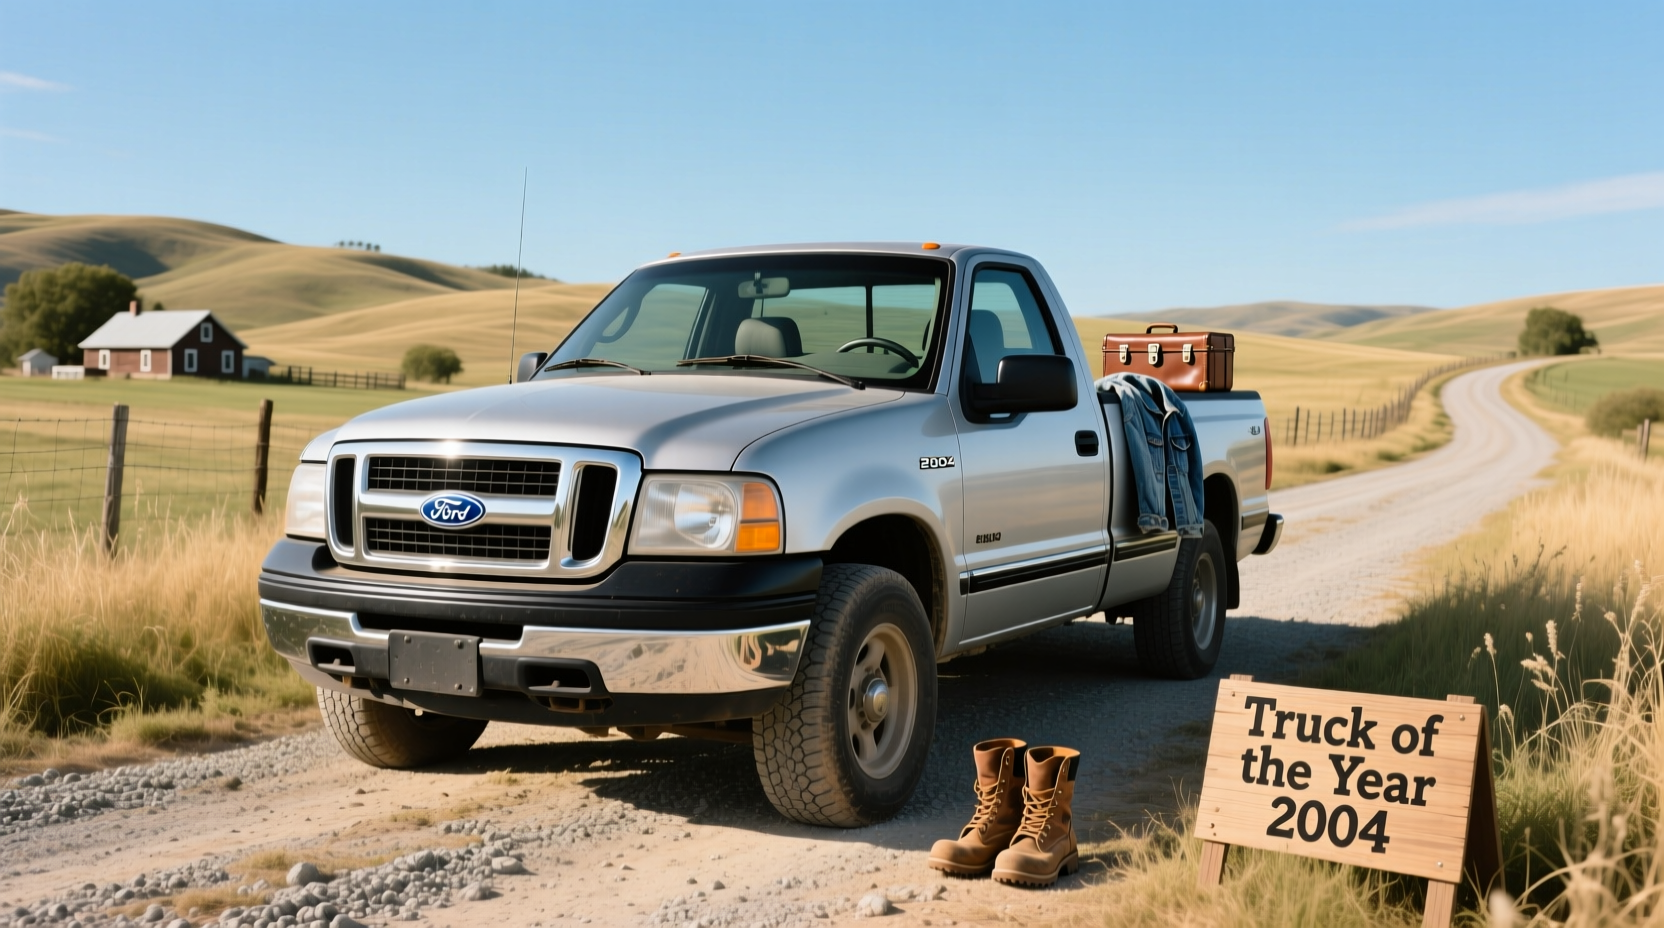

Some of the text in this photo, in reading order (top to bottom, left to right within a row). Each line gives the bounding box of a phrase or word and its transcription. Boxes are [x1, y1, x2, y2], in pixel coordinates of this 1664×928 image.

[919, 456, 955, 469] 2004
[430, 498, 472, 521] Ford
[1244, 695, 1444, 757] Truck of
[1241, 745, 1437, 807] the Year
[1266, 796, 1390, 854] 2004
